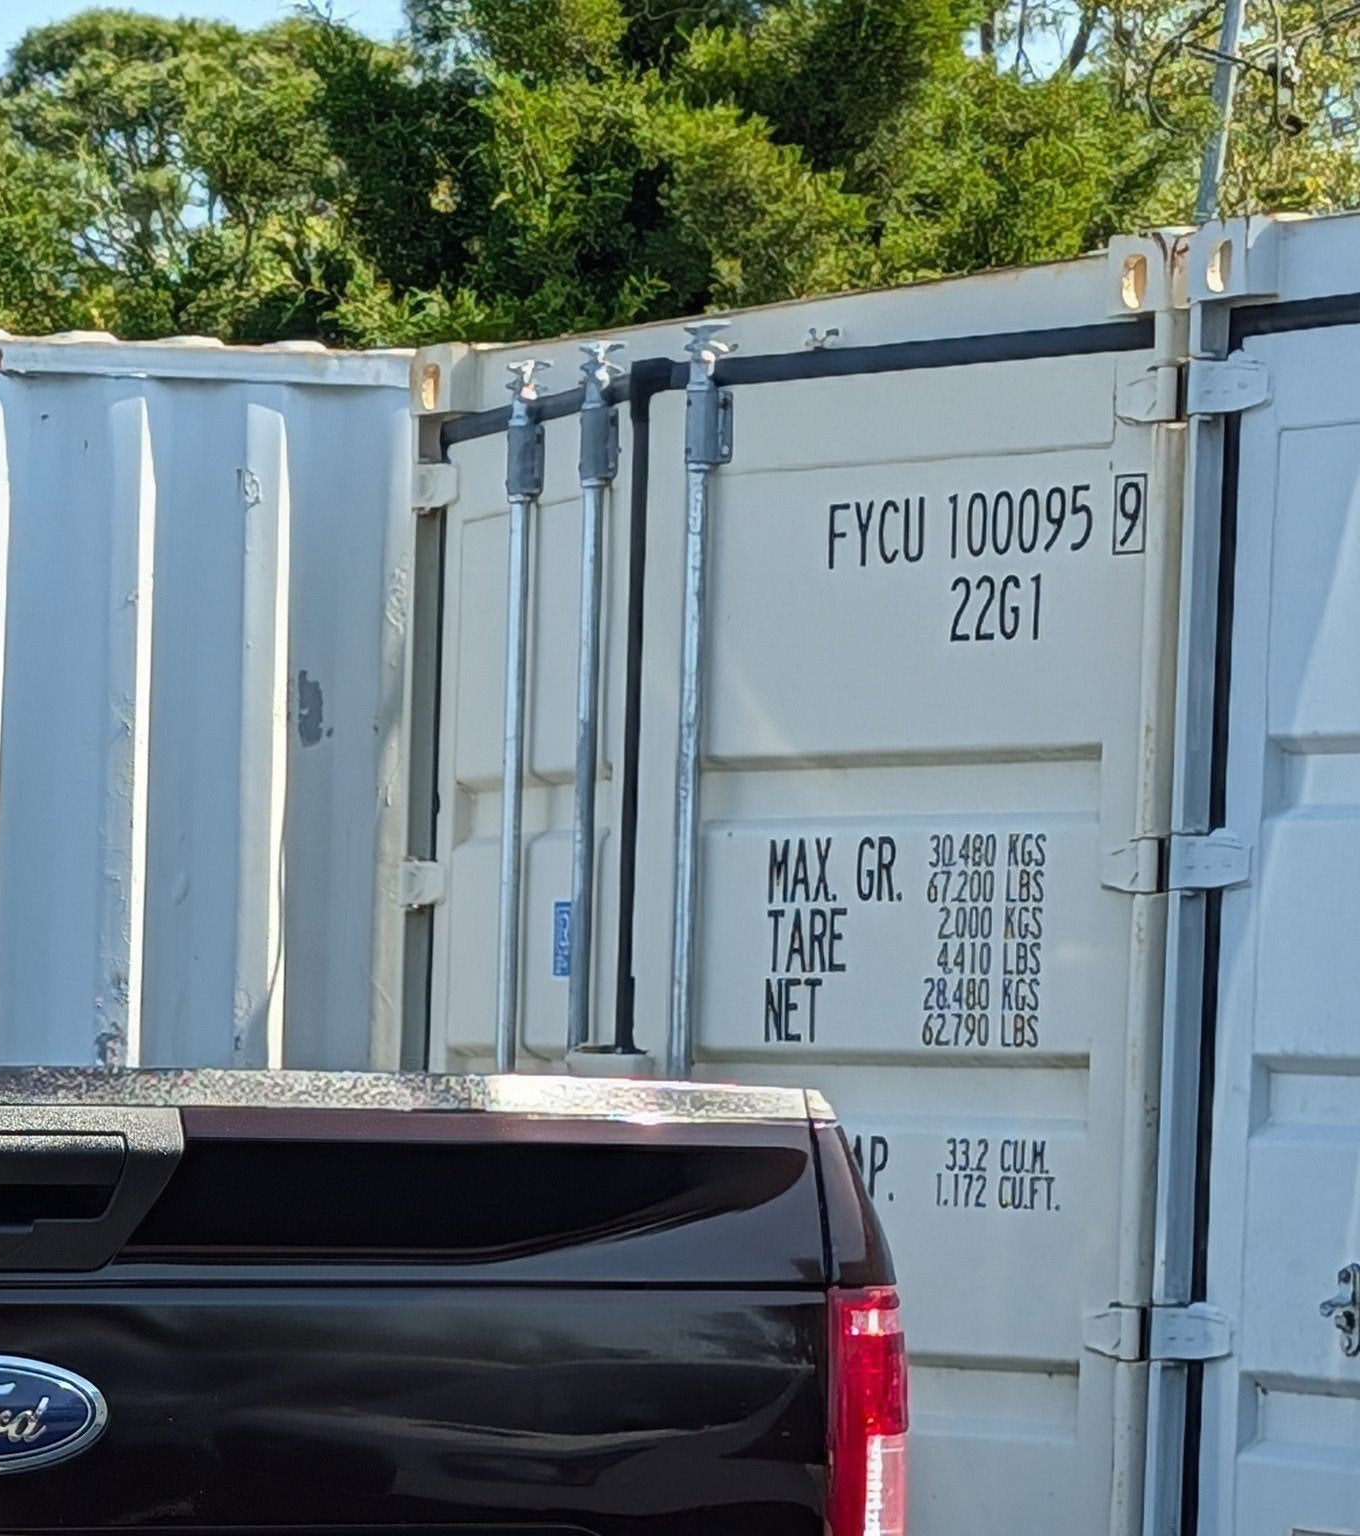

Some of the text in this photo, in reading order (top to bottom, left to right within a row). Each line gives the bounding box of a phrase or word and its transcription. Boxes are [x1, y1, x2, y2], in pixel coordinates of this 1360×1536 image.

[827, 479, 1143, 570] FYCU 100095 9
[950, 573, 1043, 642] 22G1
[1007, 833, 1047, 867] KGS
[767, 836, 903, 903] MAX. GR.
[1005, 869, 1045, 903] LBS
[1003, 906, 1043, 940] KGS
[767, 908, 848, 973] TARE
[1002, 942, 1042, 976] LBS
[764, 978, 823, 1043] NET
[1001, 978, 1040, 1012] KGS
[1000, 1013, 1039, 1048] LBS
[935, 1173, 987, 1207] 1.172
